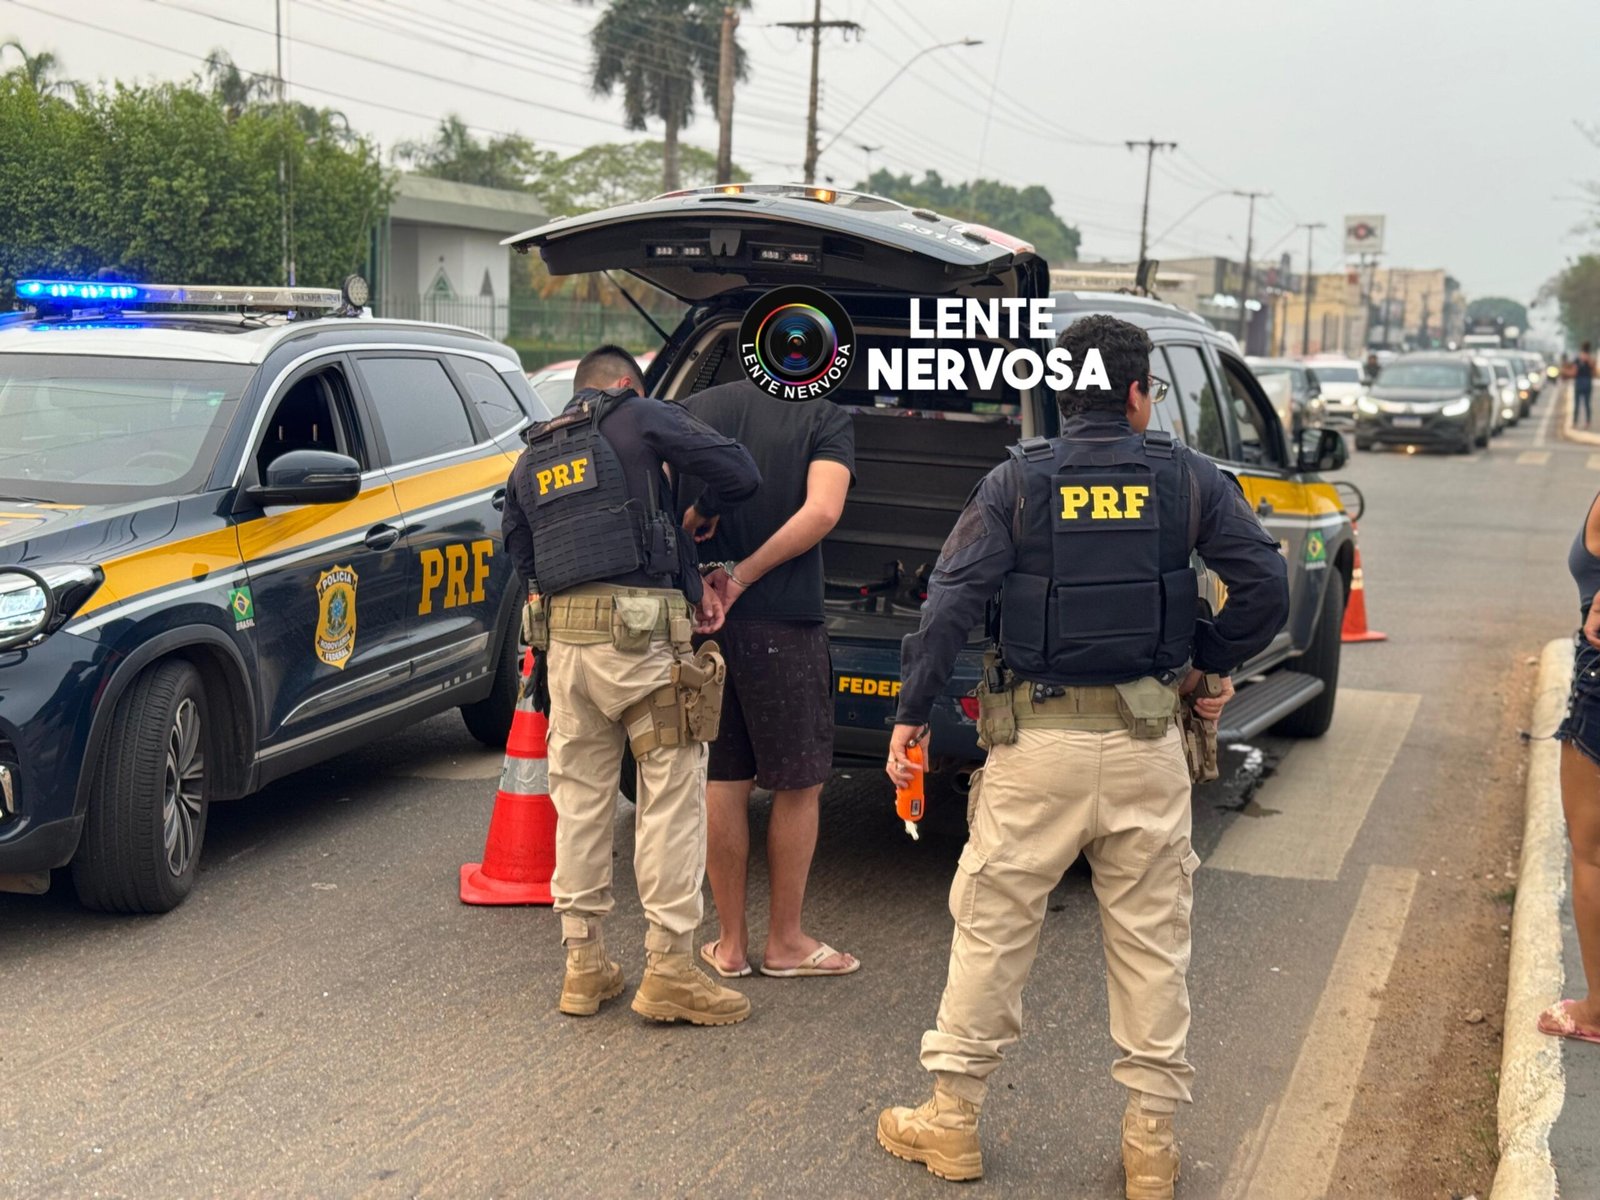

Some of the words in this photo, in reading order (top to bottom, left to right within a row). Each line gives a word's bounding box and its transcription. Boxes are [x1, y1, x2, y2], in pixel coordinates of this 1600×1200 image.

[536, 458, 588, 495] PRF
[1060, 486, 1149, 519] PRF
[418, 539, 494, 616] PRF
[236, 618, 255, 632] BRASIL
